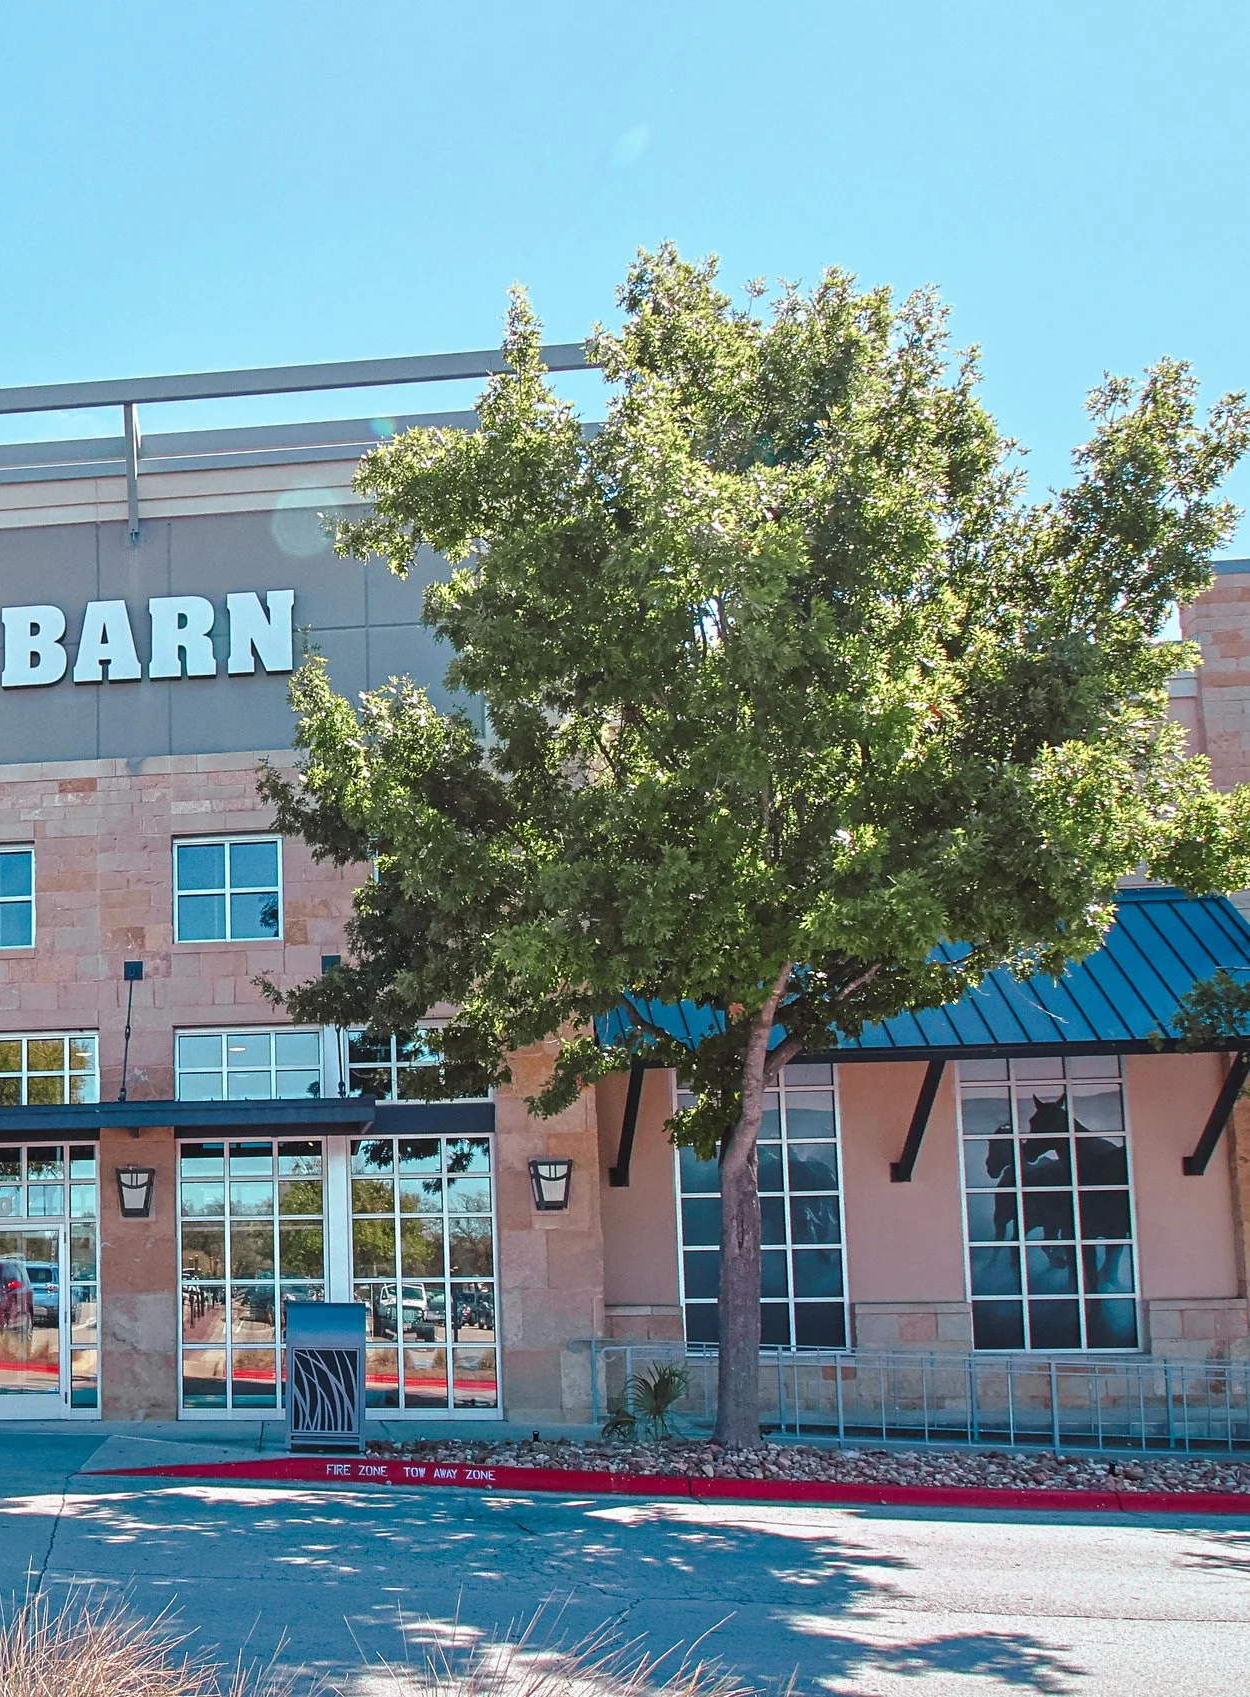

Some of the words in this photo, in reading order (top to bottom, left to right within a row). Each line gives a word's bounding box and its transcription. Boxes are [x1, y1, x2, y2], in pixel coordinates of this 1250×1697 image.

[0, 588, 295, 689] BARN
[326, 1464, 351, 1476] FIRE
[358, 1465, 388, 1477] ZONE
[403, 1466, 426, 1478] TOW
[433, 1468, 457, 1480] AWAY
[464, 1469, 496, 1481] ZONE
